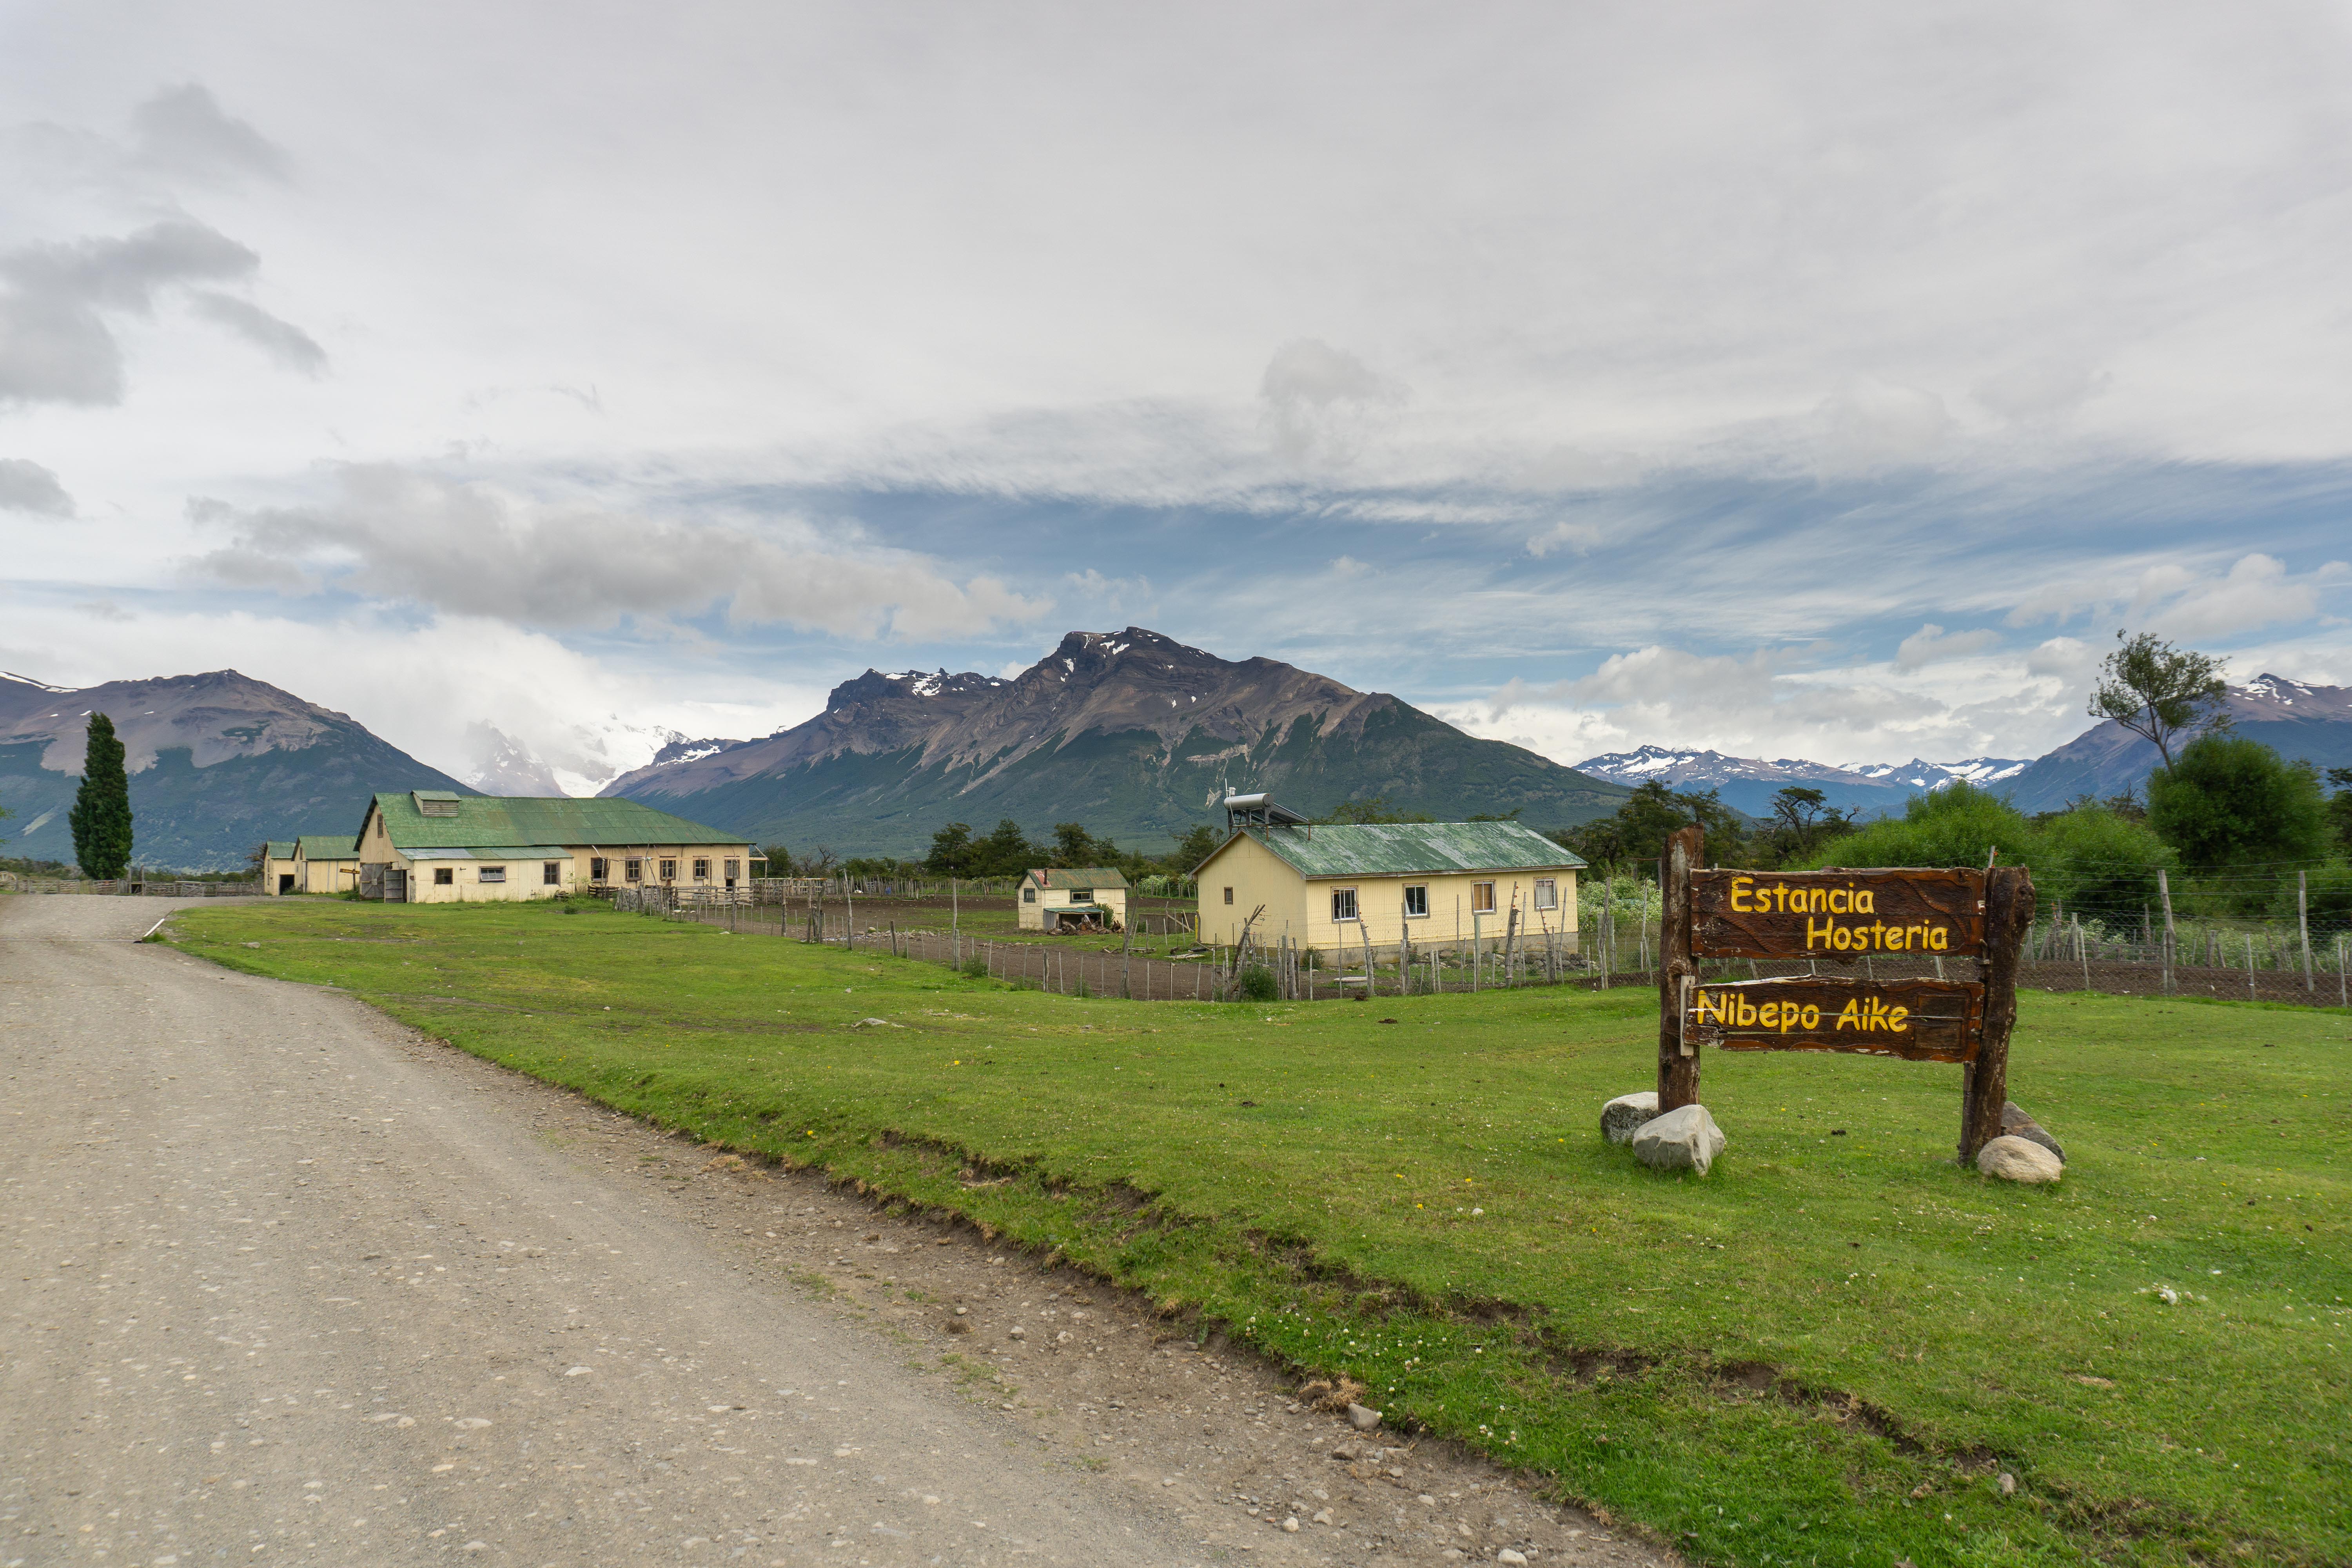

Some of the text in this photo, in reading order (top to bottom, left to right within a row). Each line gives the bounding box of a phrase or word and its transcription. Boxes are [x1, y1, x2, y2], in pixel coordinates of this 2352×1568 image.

[1730, 876, 1875, 914] Estancia
[1807, 916, 1948, 951] Hosteria
[1697, 989, 1909, 1034] Nibepo Aike
